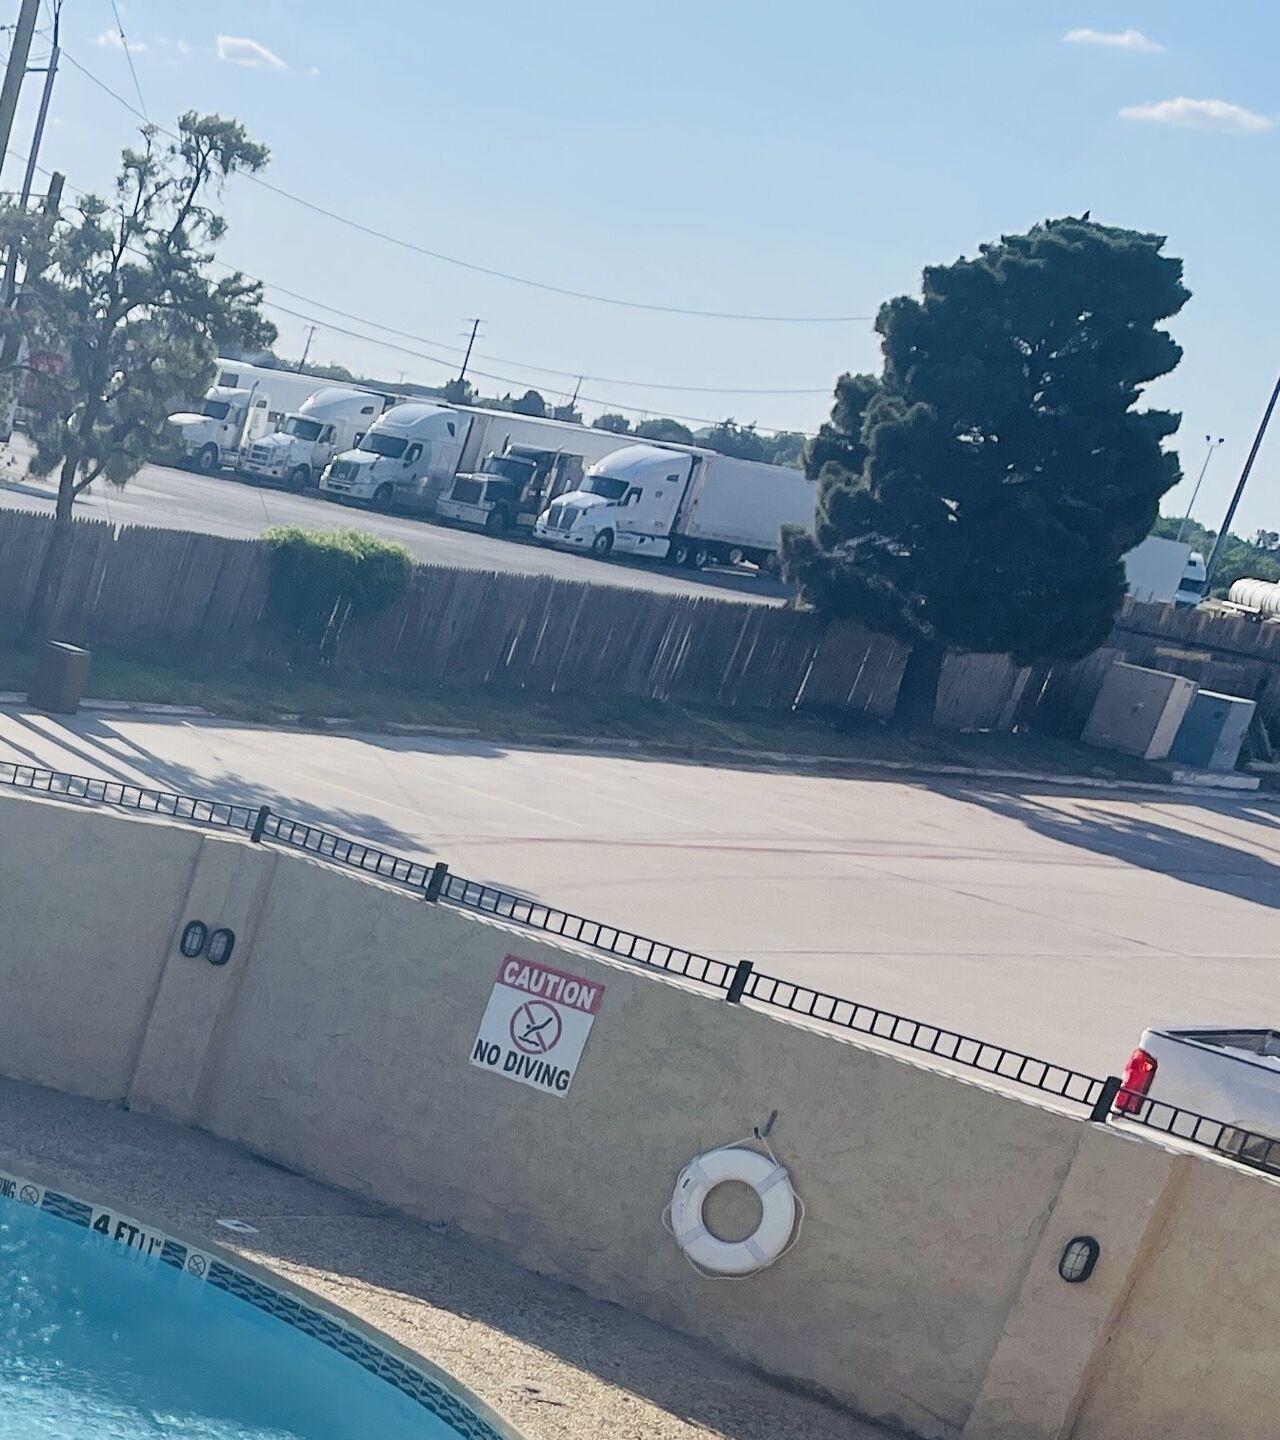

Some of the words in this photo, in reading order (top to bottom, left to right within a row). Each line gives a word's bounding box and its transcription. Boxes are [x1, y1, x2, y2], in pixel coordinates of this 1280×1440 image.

[504, 961, 596, 1010] CAUTION
[473, 1039, 500, 1065] NO
[503, 1051, 571, 1091] DIVING
[93, 1214, 110, 1235] 4
